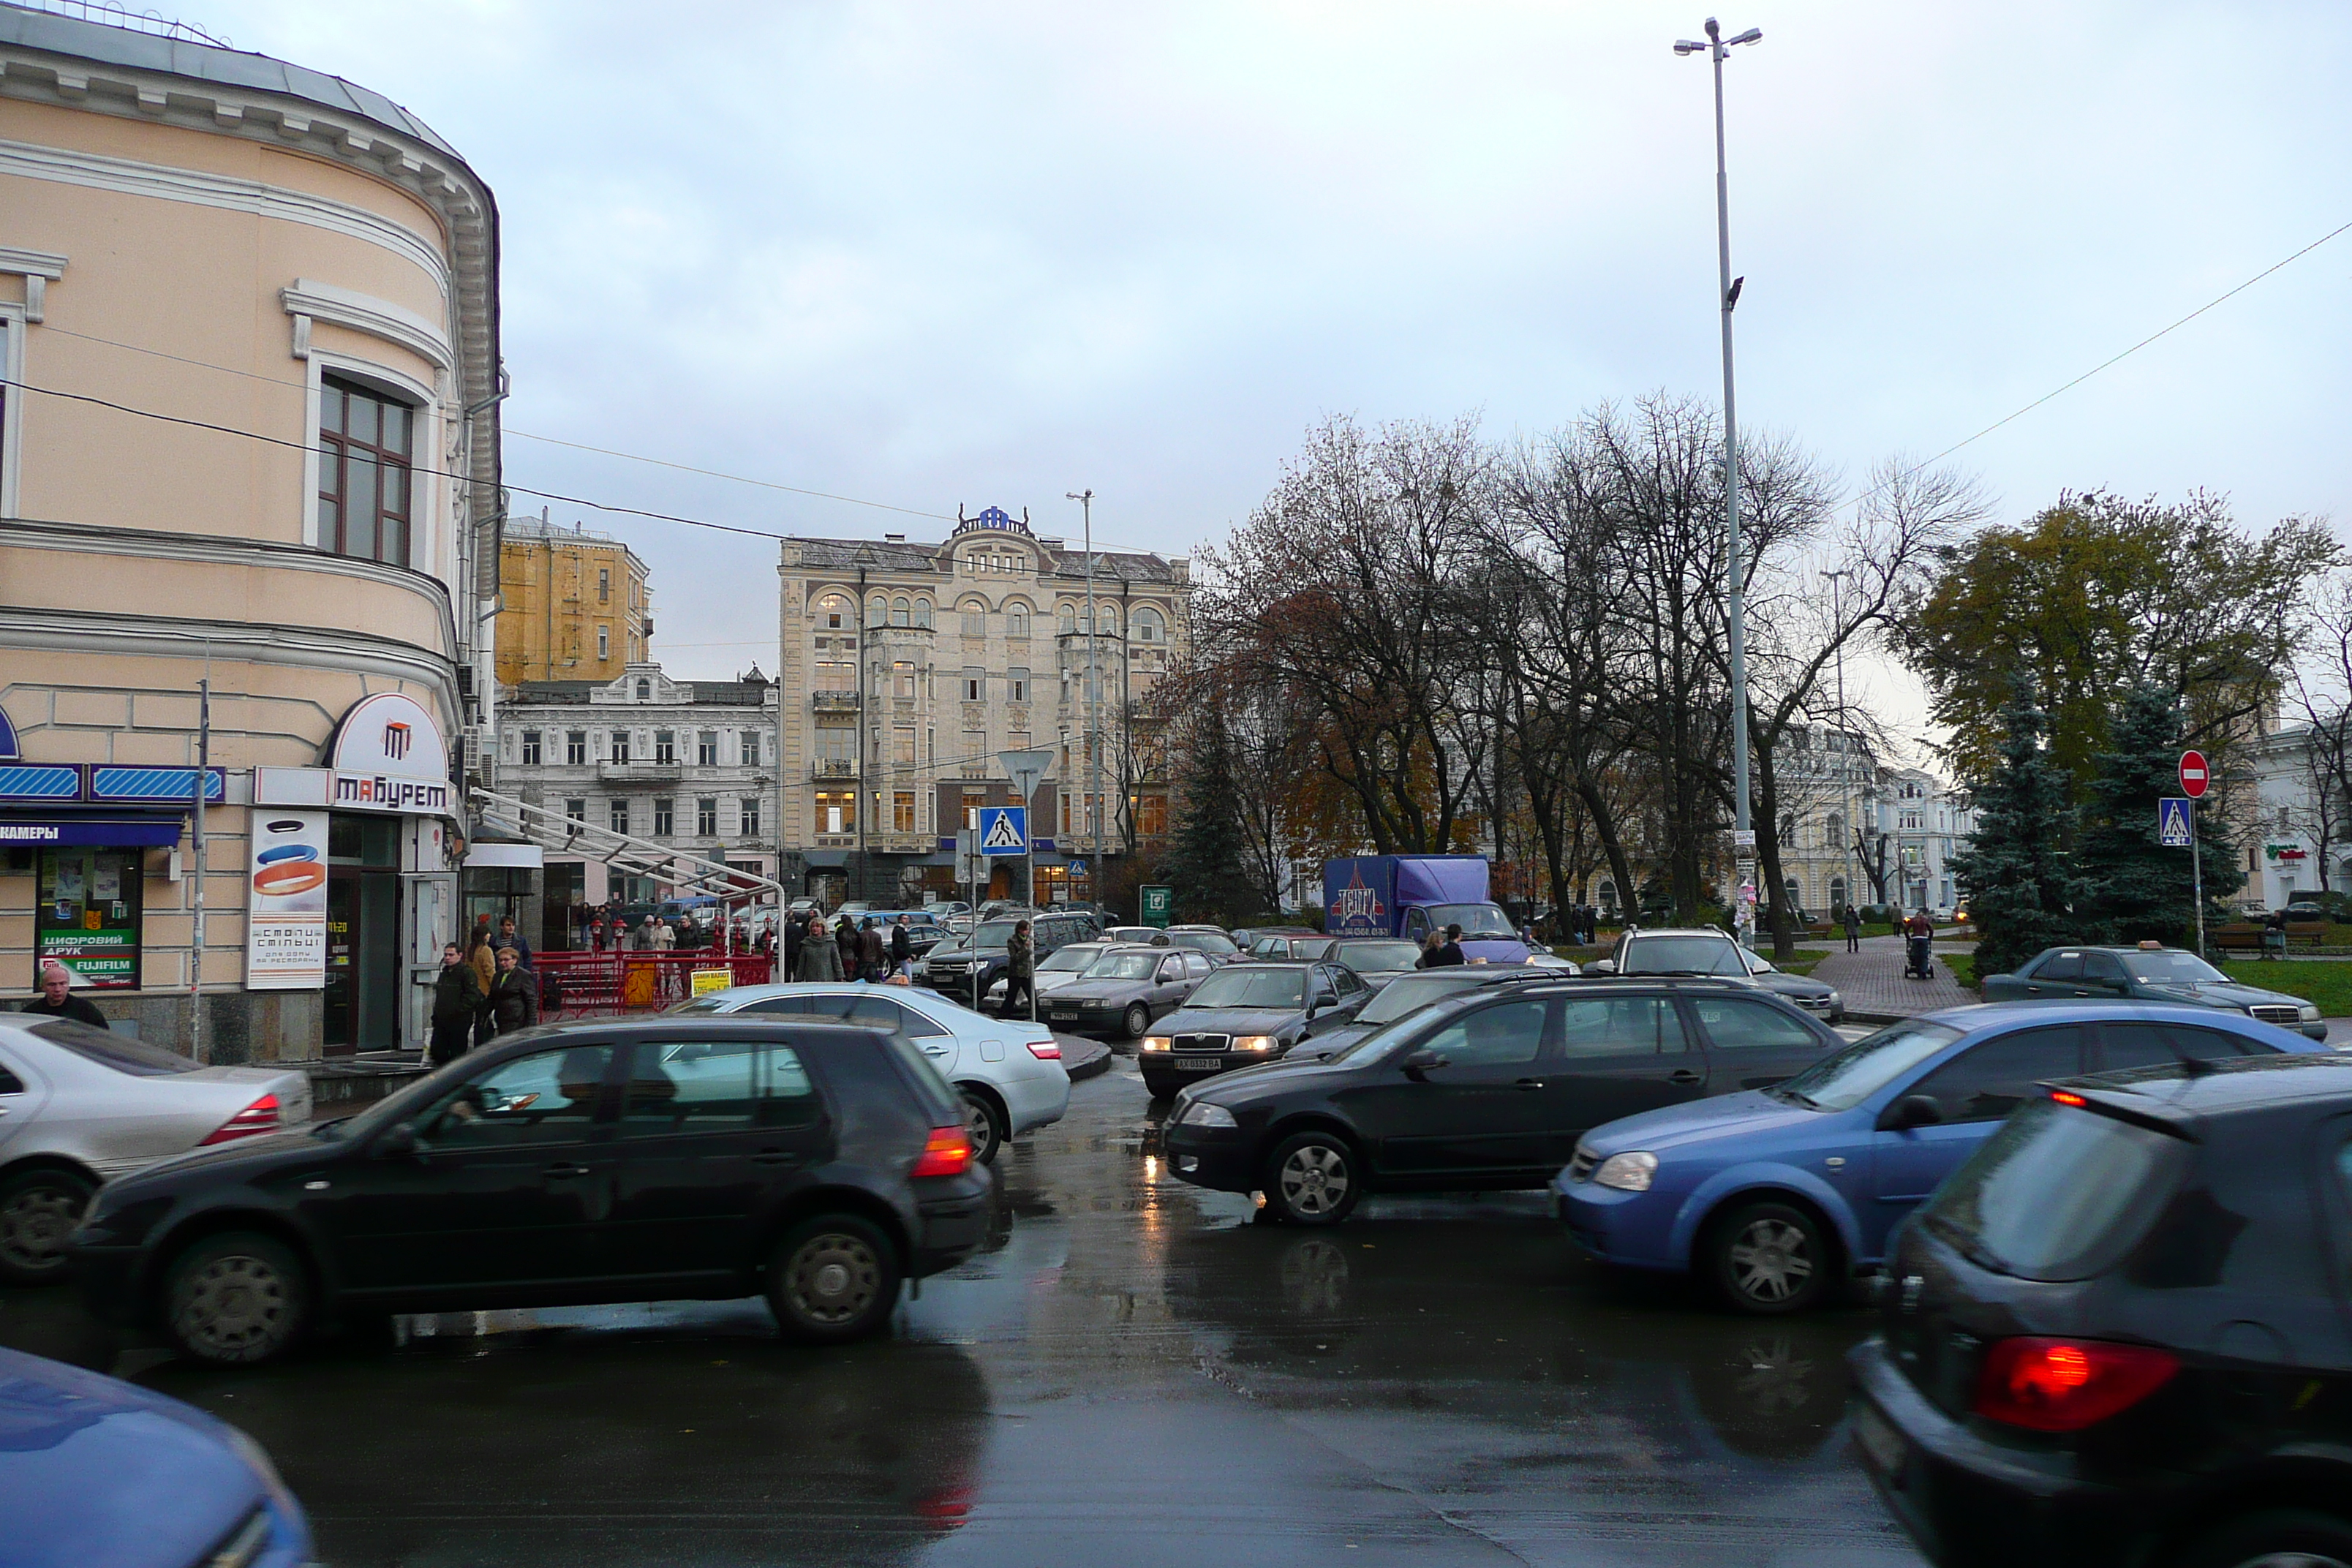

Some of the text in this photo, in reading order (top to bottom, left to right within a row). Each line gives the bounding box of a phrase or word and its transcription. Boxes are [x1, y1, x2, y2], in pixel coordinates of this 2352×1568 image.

[0, 826, 59, 840] КАМЕРЫ
[45, 935, 123, 946] ЦИФРОВИЙ
[45, 947, 82, 955] ДРУК
[77, 961, 130, 970] FUJIFILM
